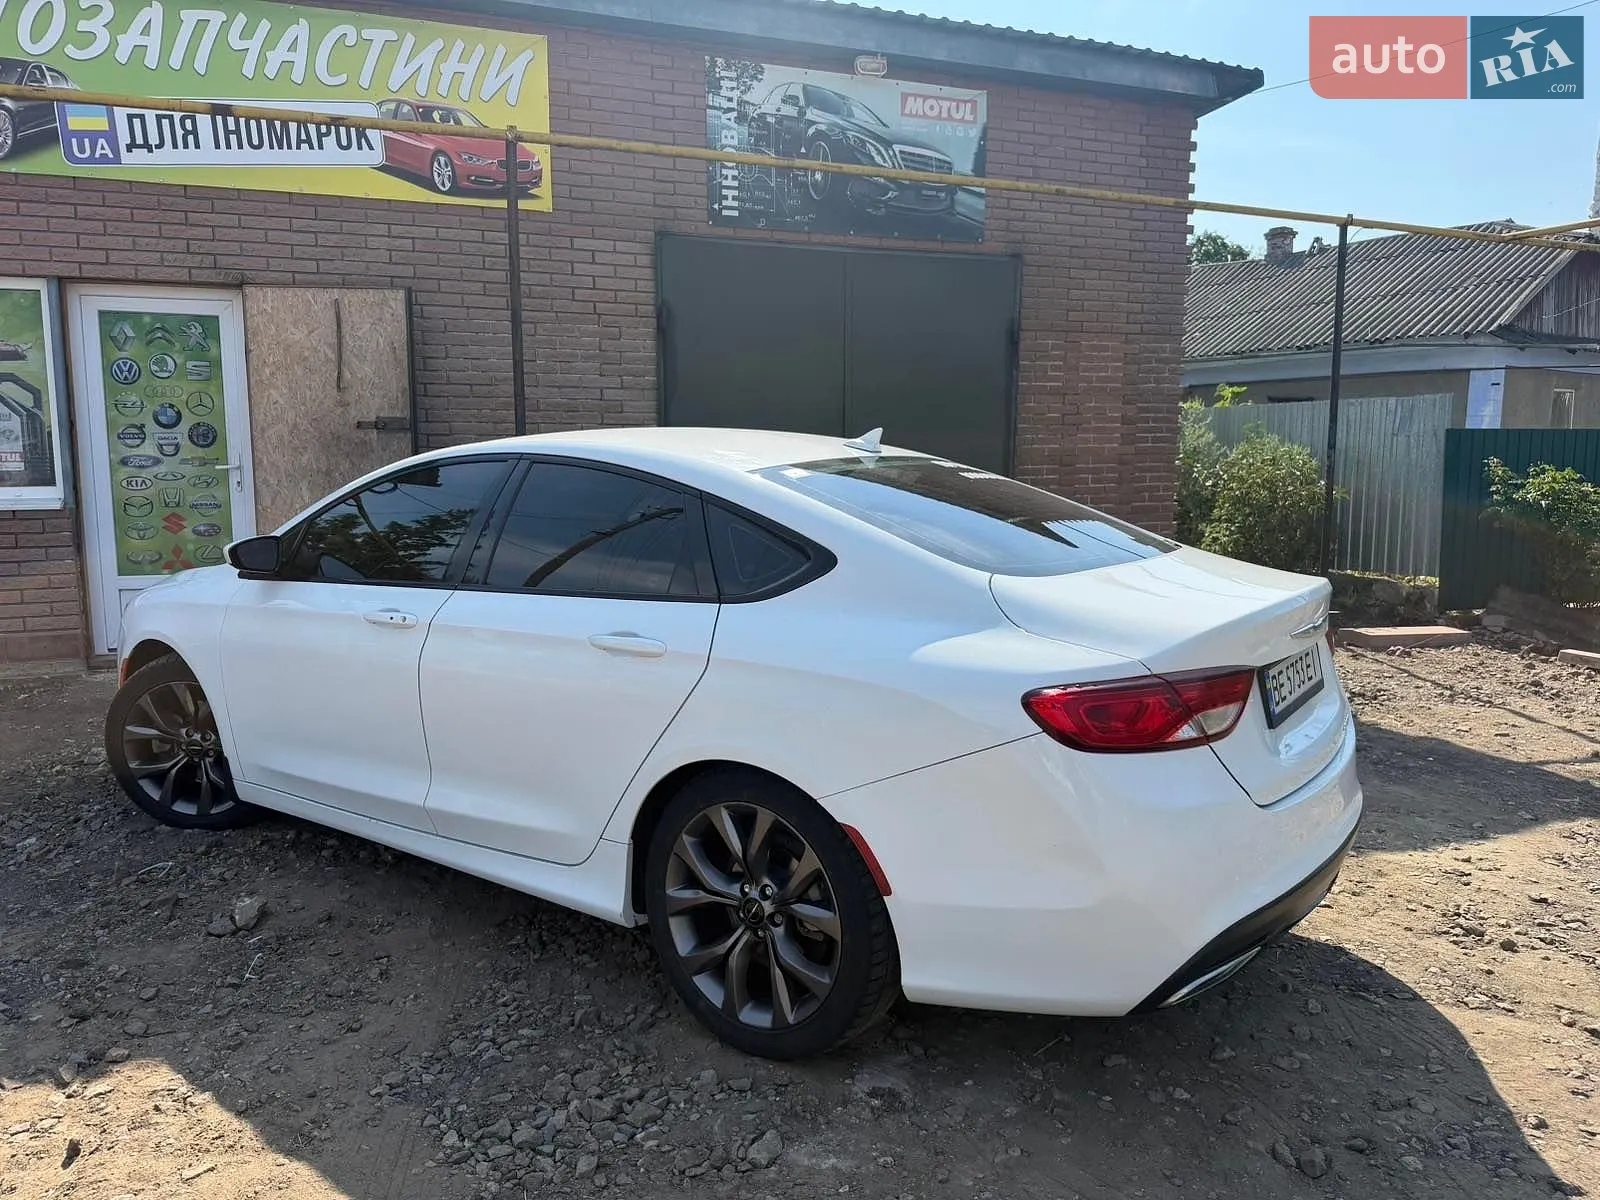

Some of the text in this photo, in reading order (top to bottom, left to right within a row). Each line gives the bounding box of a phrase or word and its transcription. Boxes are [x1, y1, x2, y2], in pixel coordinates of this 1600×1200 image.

[0, 0, 535, 107] ОЗАПЧАСТИНИ
[904, 96, 975, 121] MOTUL
[72, 138, 114, 159] UA
[126, 113, 375, 154] ДЛЯ ІНОМАРОК
[126, 479, 148, 488] KIA
[1271, 670, 1287, 706] BE
